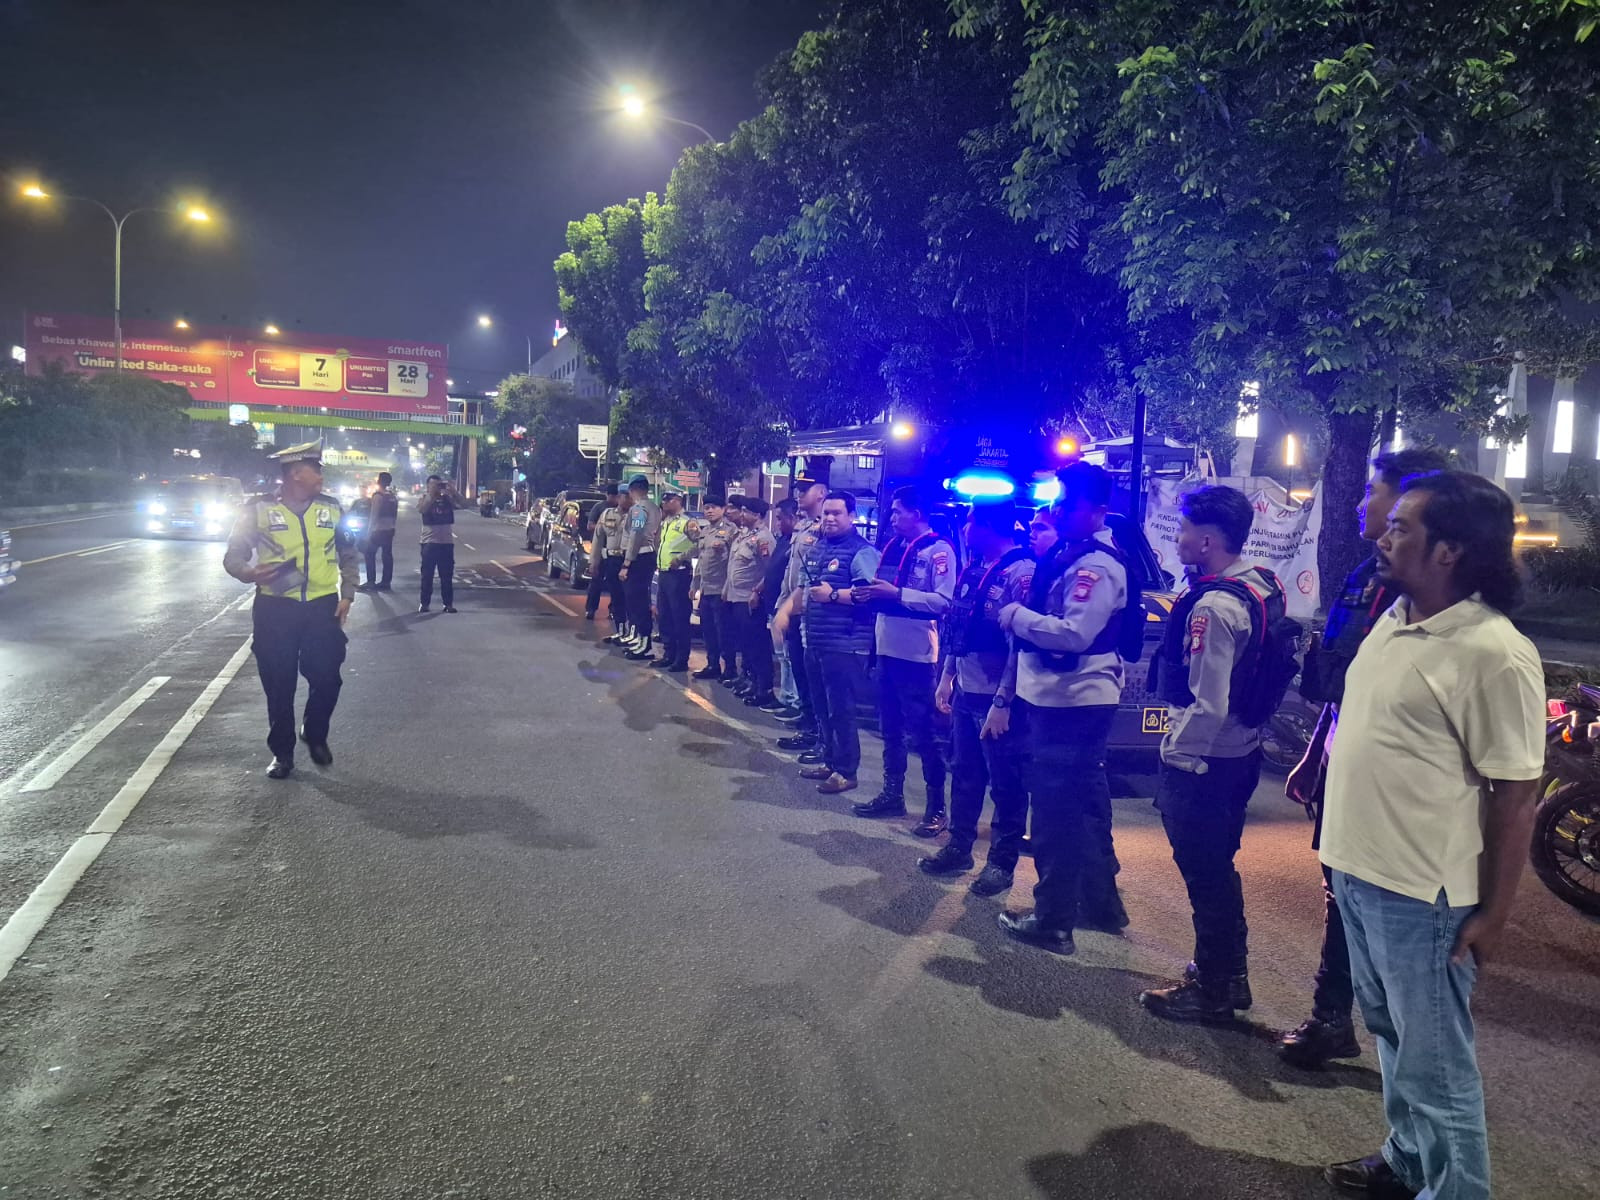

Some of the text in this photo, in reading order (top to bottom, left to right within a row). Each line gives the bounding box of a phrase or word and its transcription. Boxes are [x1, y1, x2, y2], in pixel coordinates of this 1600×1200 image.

[41, 335, 75, 345] Bebas
[131, 341, 188, 354] Internetan
[387, 345, 442, 358] smartfren
[146, 360, 212, 374] Suka-suka
[315, 358, 327, 371] 7
[397, 364, 419, 378] 28
[312, 371, 330, 379] Hari
[400, 377, 417, 385] Hari
